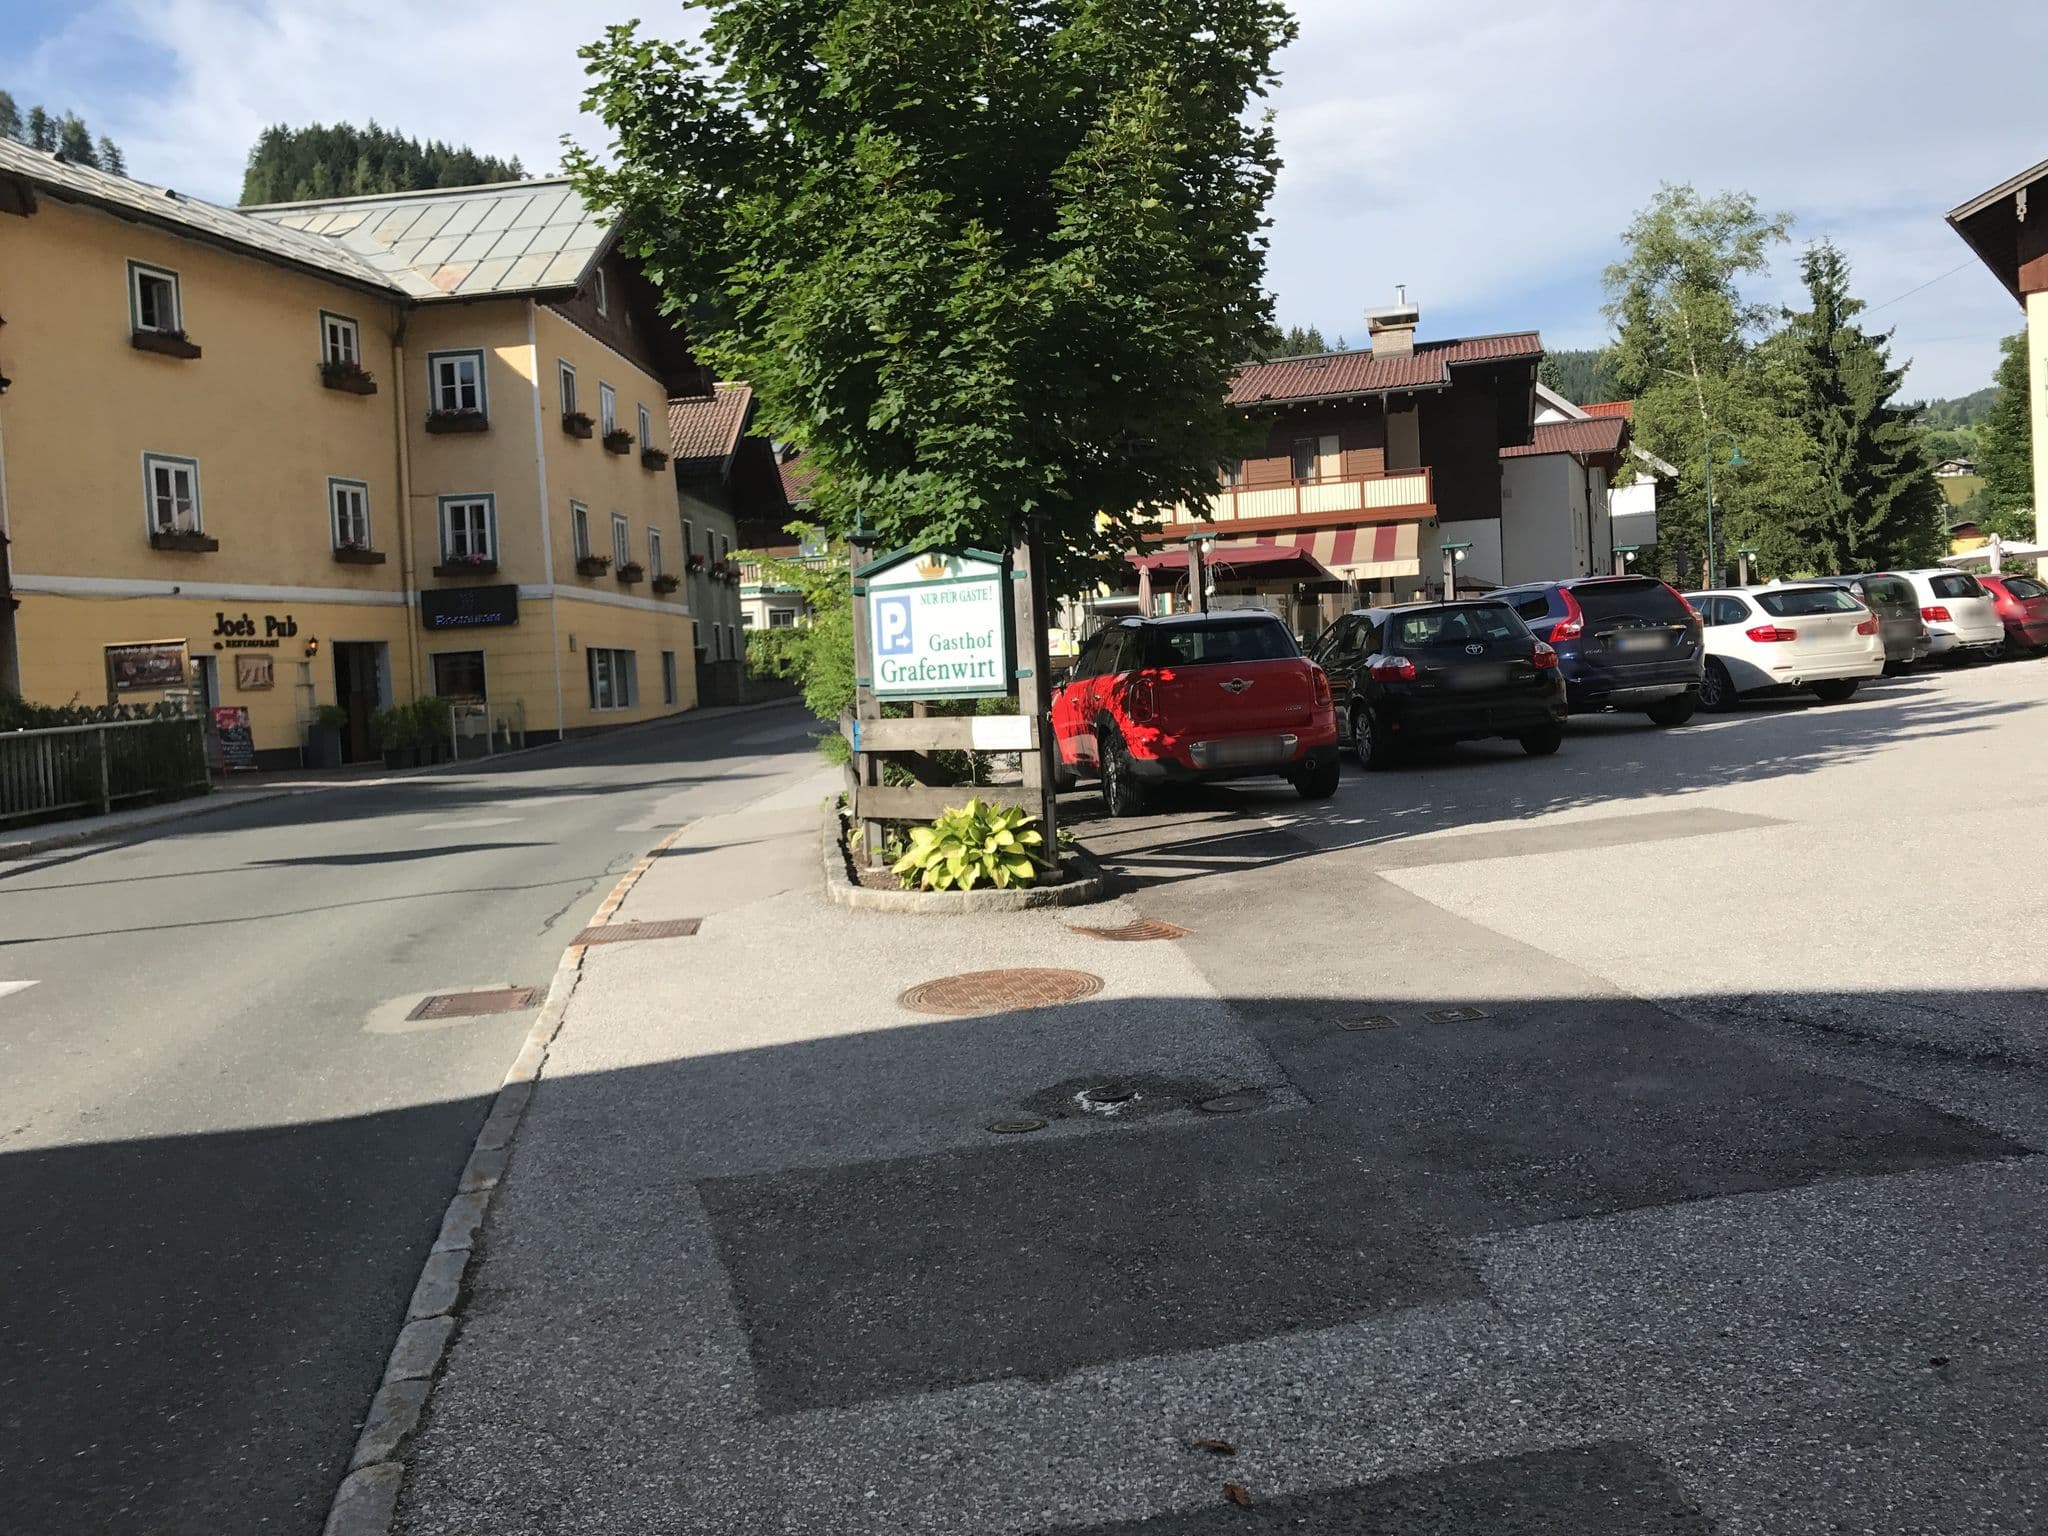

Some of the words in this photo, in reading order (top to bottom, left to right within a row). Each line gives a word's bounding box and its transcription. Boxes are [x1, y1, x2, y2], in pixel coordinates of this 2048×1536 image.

[213, 612, 256, 636] Joe's
[265, 615, 298, 637] Pub
[929, 629, 994, 651] Gasthof
[880, 655, 996, 683] Grafenwirt
